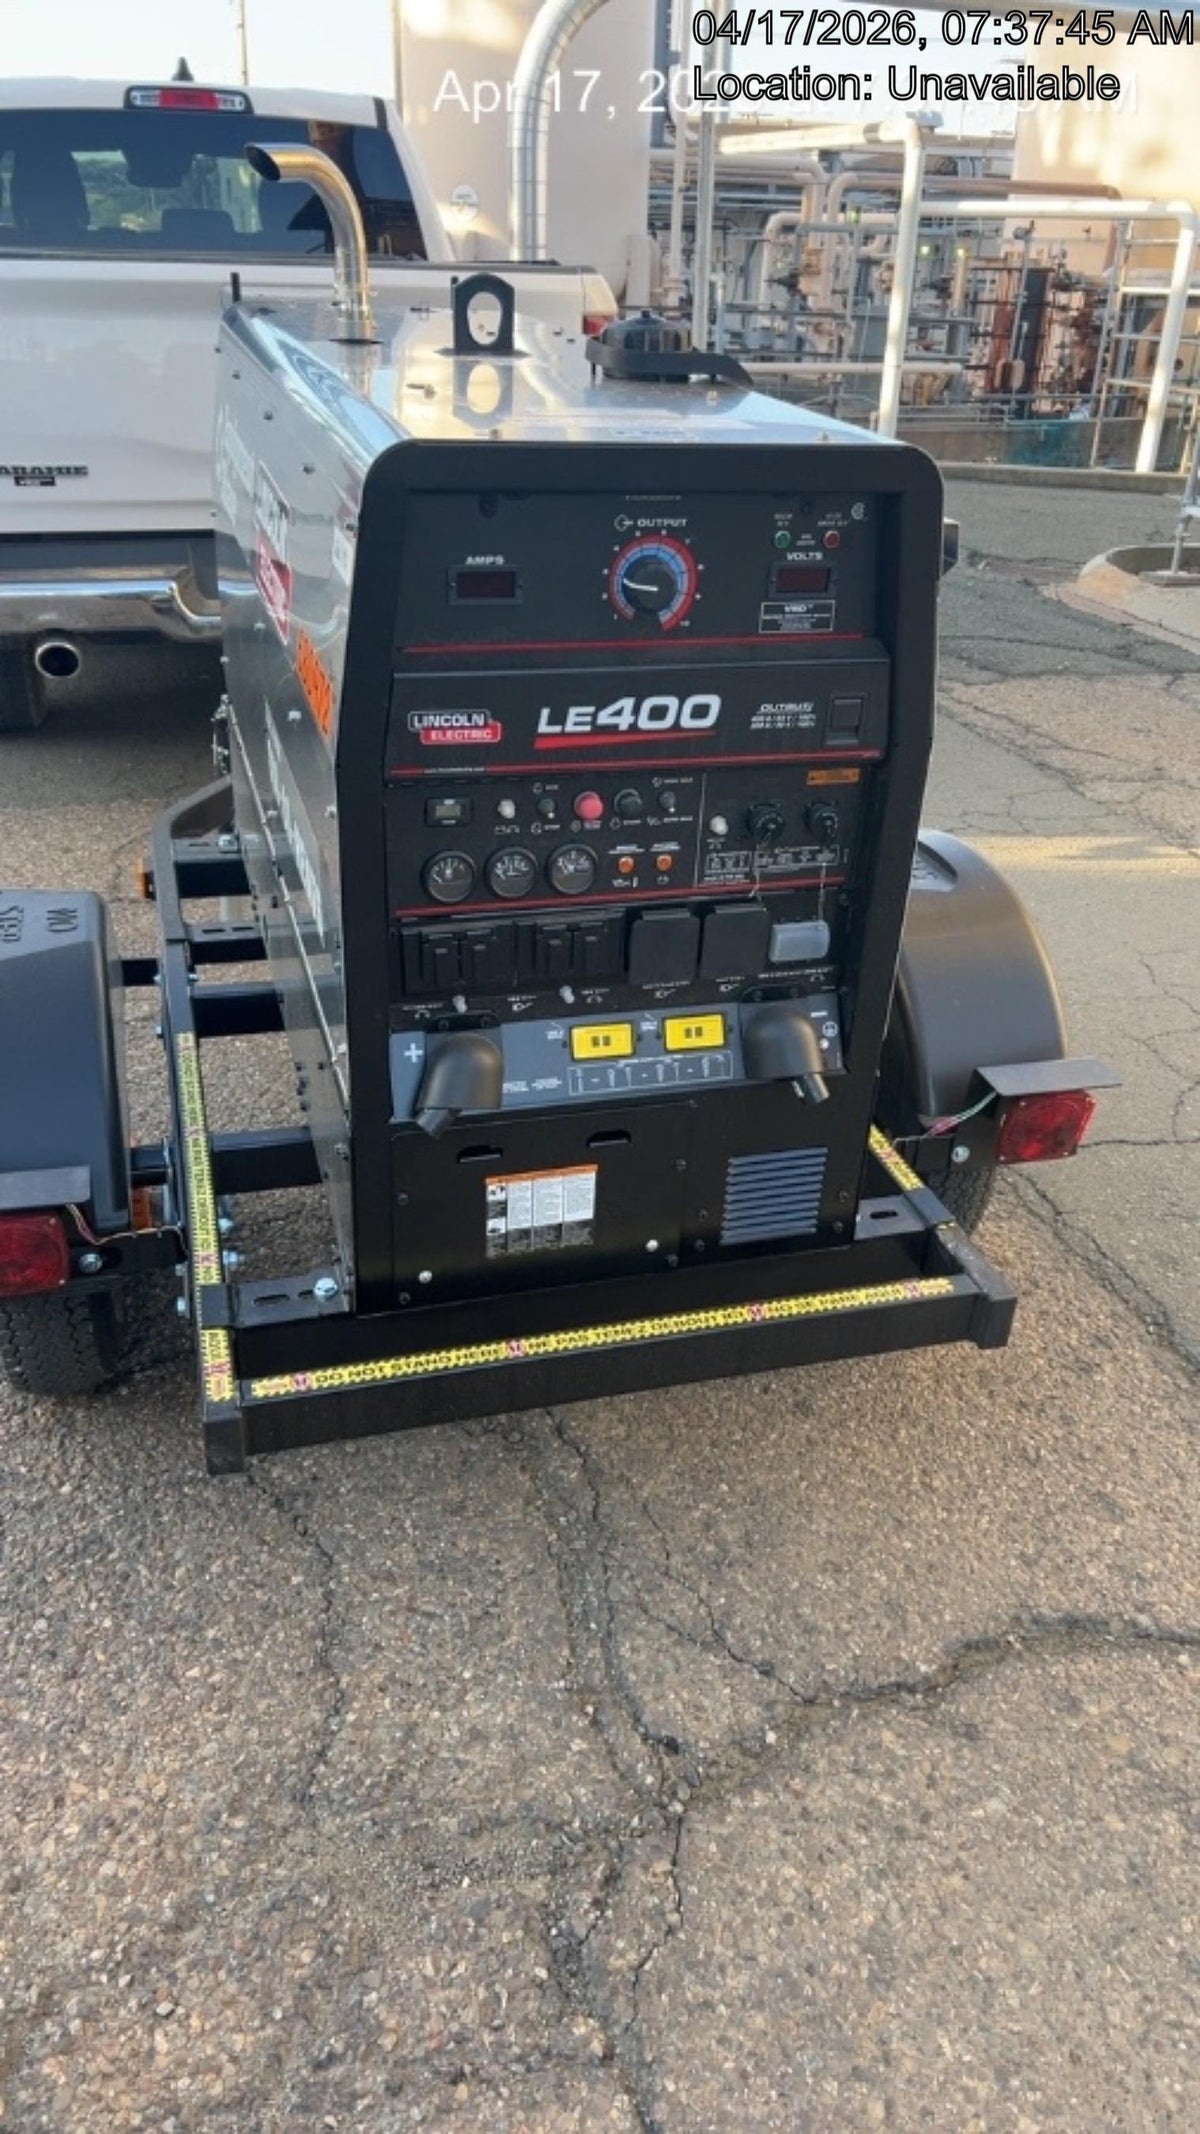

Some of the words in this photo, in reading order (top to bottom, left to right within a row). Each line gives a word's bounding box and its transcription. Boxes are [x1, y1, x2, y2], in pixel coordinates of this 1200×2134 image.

[636, 518, 689, 528] OUTPUT
[465, 554, 504, 566] AMPS
[786, 551, 823, 561] VOLTS
[537, 694, 722, 734] LE400
[413, 712, 485, 729] LINCOLN
[430, 728, 493, 741] ELECTRIC
